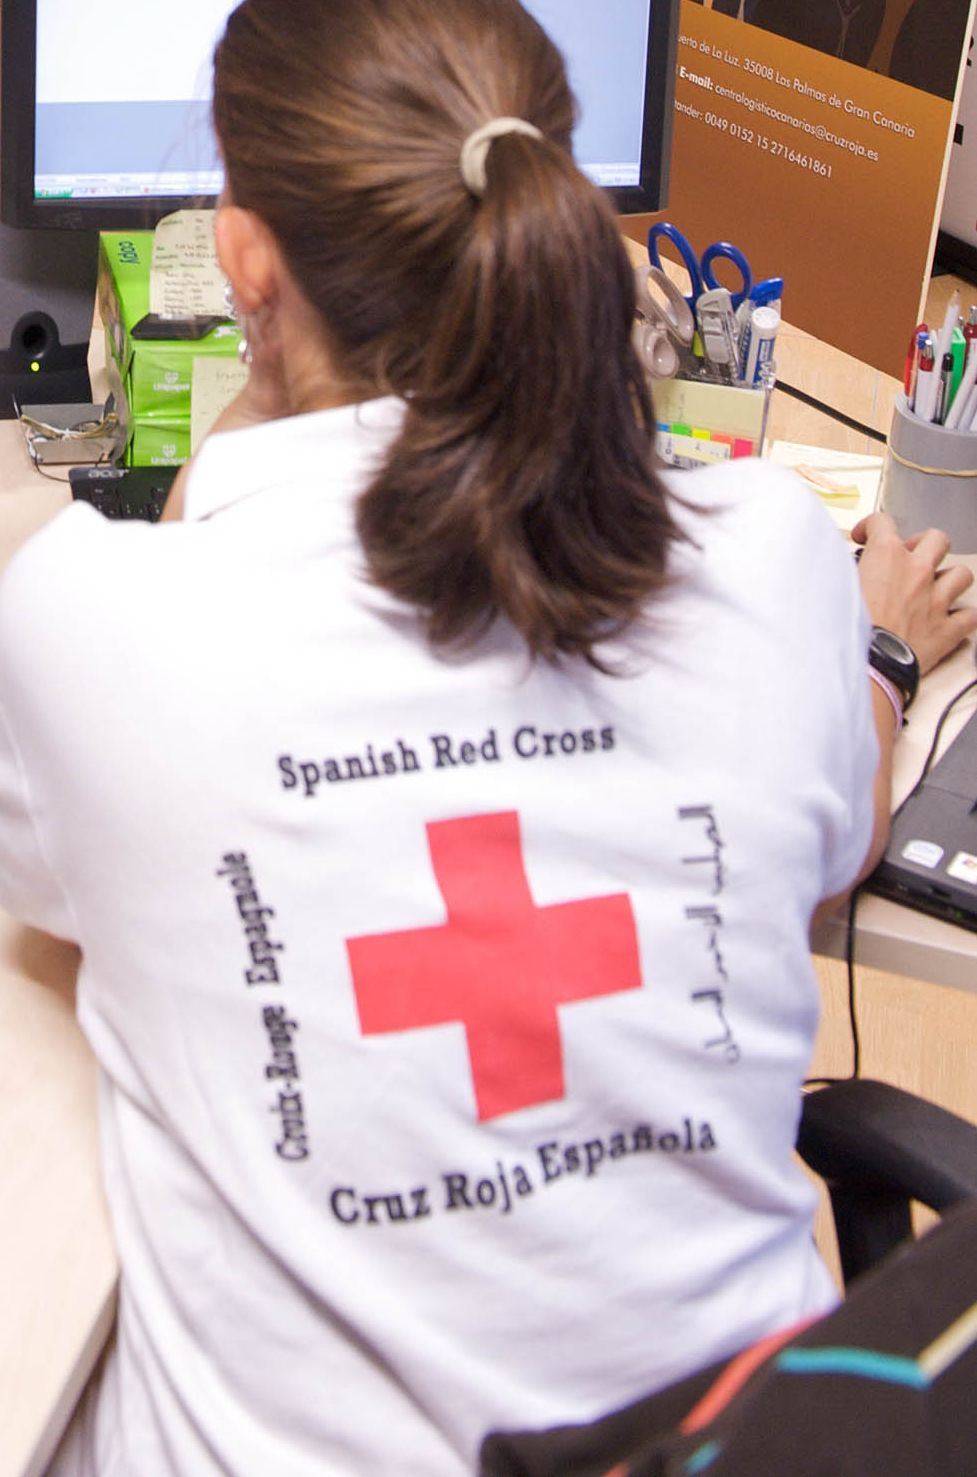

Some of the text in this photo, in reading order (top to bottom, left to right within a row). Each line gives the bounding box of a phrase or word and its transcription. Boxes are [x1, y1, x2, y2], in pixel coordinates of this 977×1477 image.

[679, 65, 713, 91] E-mail:
[699, 39, 711, 54] de
[712, 44, 722, 59] La
[743, 58, 774, 80] 35008
[775, 71, 791, 89] Las
[793, 77, 826, 103] Palmas
[828, 93, 842, 109] de
[844, 99, 870, 121] Gran
[872, 111, 916, 138] Canaria
[704, 111, 728, 132] 0049
[729, 123, 754, 145] 0152
[756, 134, 769, 150] 15
[770, 142, 833, 179] 2716461861
[88, 467, 129, 479] acer
[278, 724, 616, 797] Spanish Red Cross
[216, 850, 310, 1164] Croix-Rouge Espagnole
[330, 1118, 718, 1226] Cruz Roja Española
